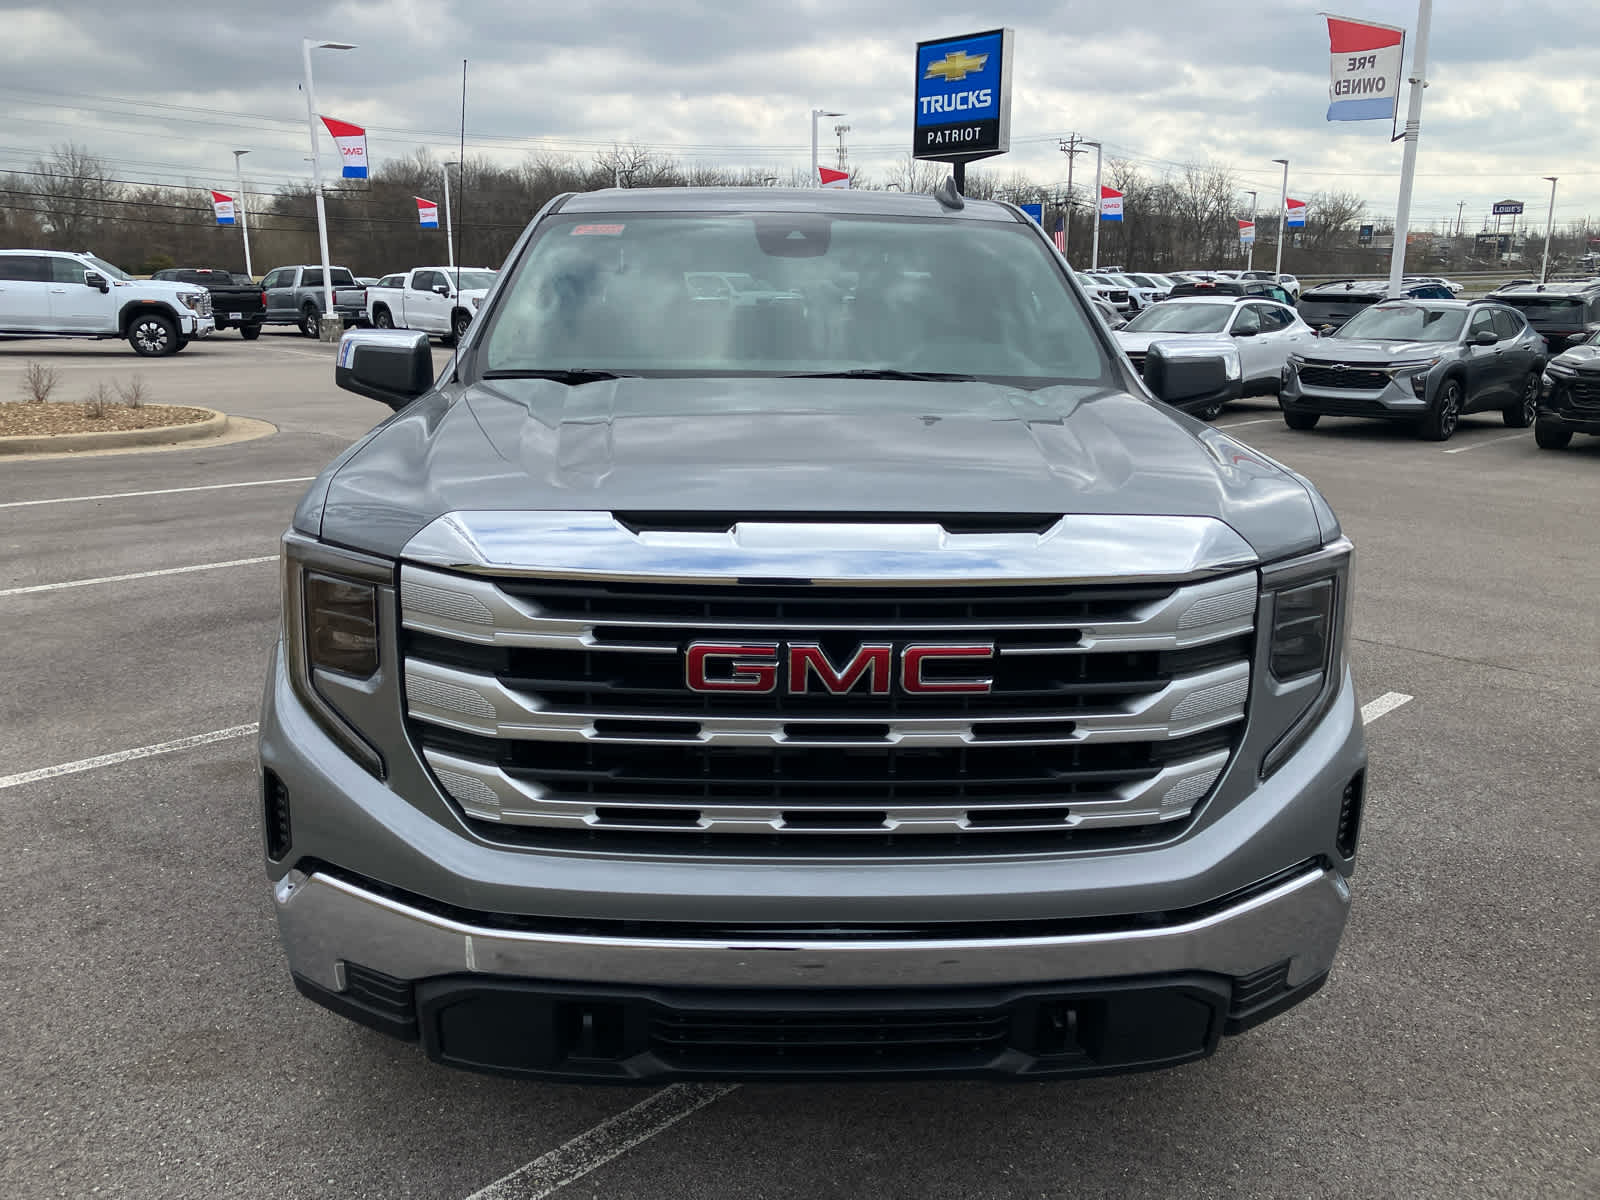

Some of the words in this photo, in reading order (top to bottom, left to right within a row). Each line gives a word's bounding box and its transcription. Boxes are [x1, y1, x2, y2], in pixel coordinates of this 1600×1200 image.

[920, 88, 992, 115] TRUCKS
[927, 127, 982, 145] PATRIOT
[686, 640, 994, 695] GMC
